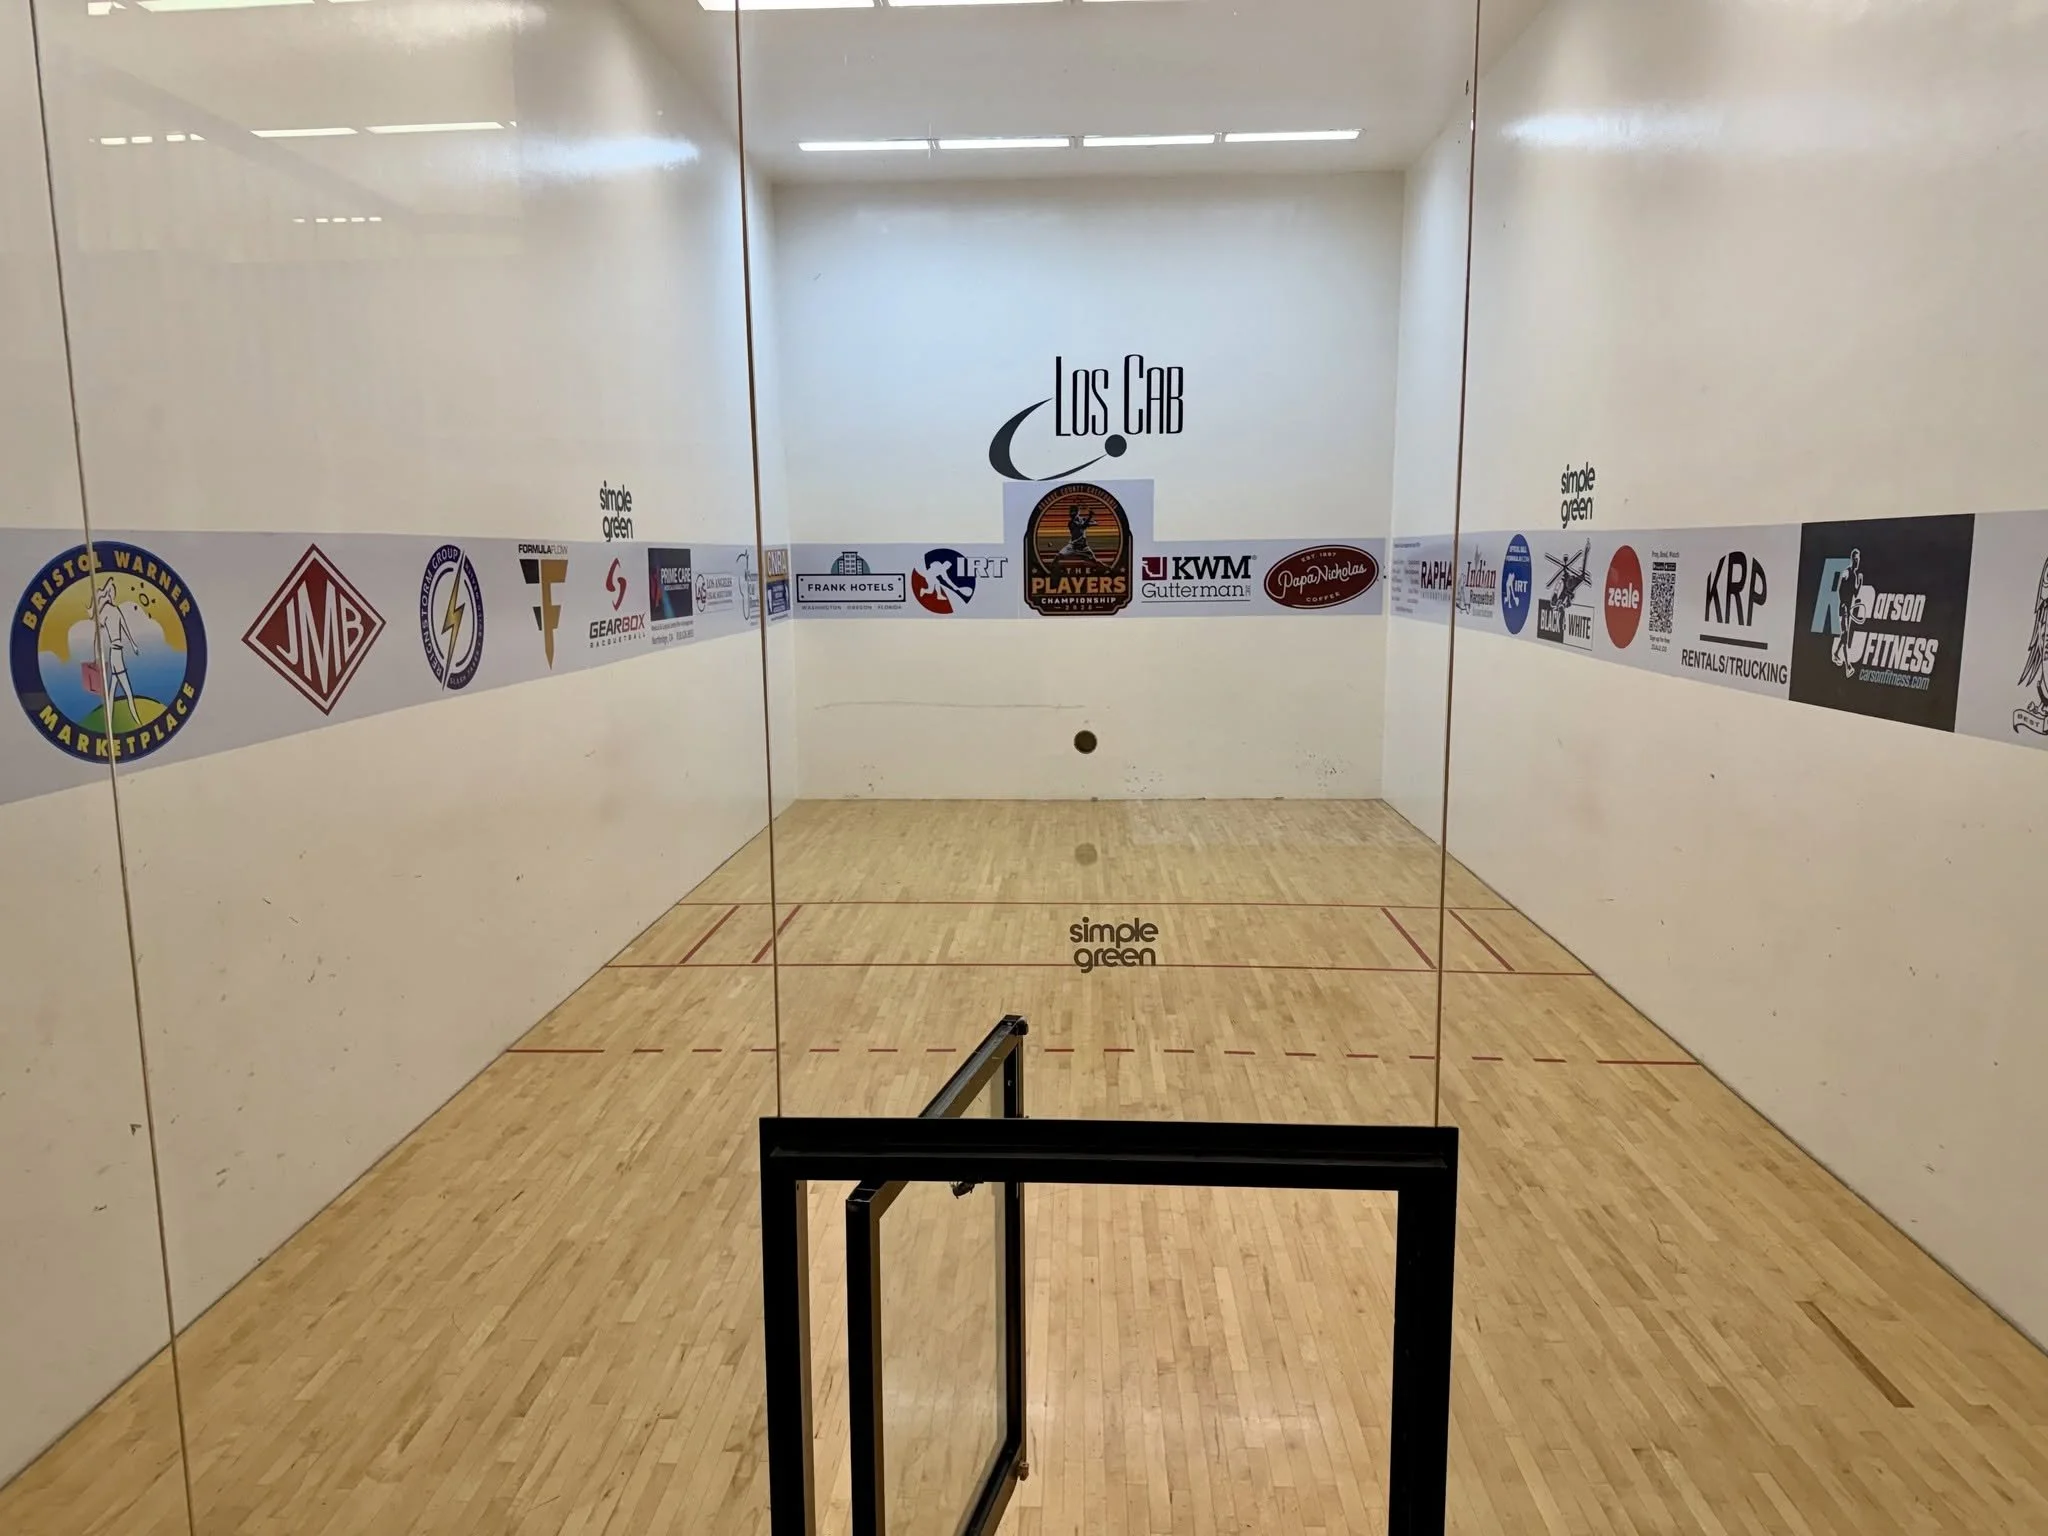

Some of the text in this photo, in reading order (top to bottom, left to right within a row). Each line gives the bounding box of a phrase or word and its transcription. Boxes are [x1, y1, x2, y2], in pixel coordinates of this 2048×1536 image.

[1055, 354, 1184, 436] LOS CAB
[1561, 462, 1596, 499] simple
[600, 480, 633, 518] simple
[1561, 497, 1593, 529] green
[603, 516, 634, 543] green
[432, 547, 459, 569] GROUP
[956, 557, 1009, 579] IRT
[660, 567, 692, 584] PRIME CARE
[808, 583, 894, 593] FRANK HOTELS
[1031, 576, 1127, 595] PLAYERS
[1514, 579, 1529, 593] IRT
[1704, 551, 1768, 627] KRP
[22, 549, 192, 630] BRISTOL WARNER
[1041, 597, 1117, 605] CHAMPIONSHIP
[1141, 582, 1245, 599] Gutterman
[1306, 591, 1341, 603] COFFEE
[1607, 582, 1641, 609] zeale
[276, 579, 366, 694] JMB
[589, 612, 647, 640] GEARBOX
[1540, 608, 1561, 633] BLACK
[1568, 613, 1592, 640] WHITE
[590, 633, 647, 649] RACQUETBALL
[1862, 631, 1939, 674] FITNESS
[1681, 648, 1788, 685] RENTALS/TRUCKING
[1859, 669, 1931, 690] carsonfitness.com
[39, 682, 195, 757] MARKETPLACE
[2016, 712, 2041, 728] BEST
[1069, 916, 1159, 949] simple
[1073, 947, 1156, 974] green
